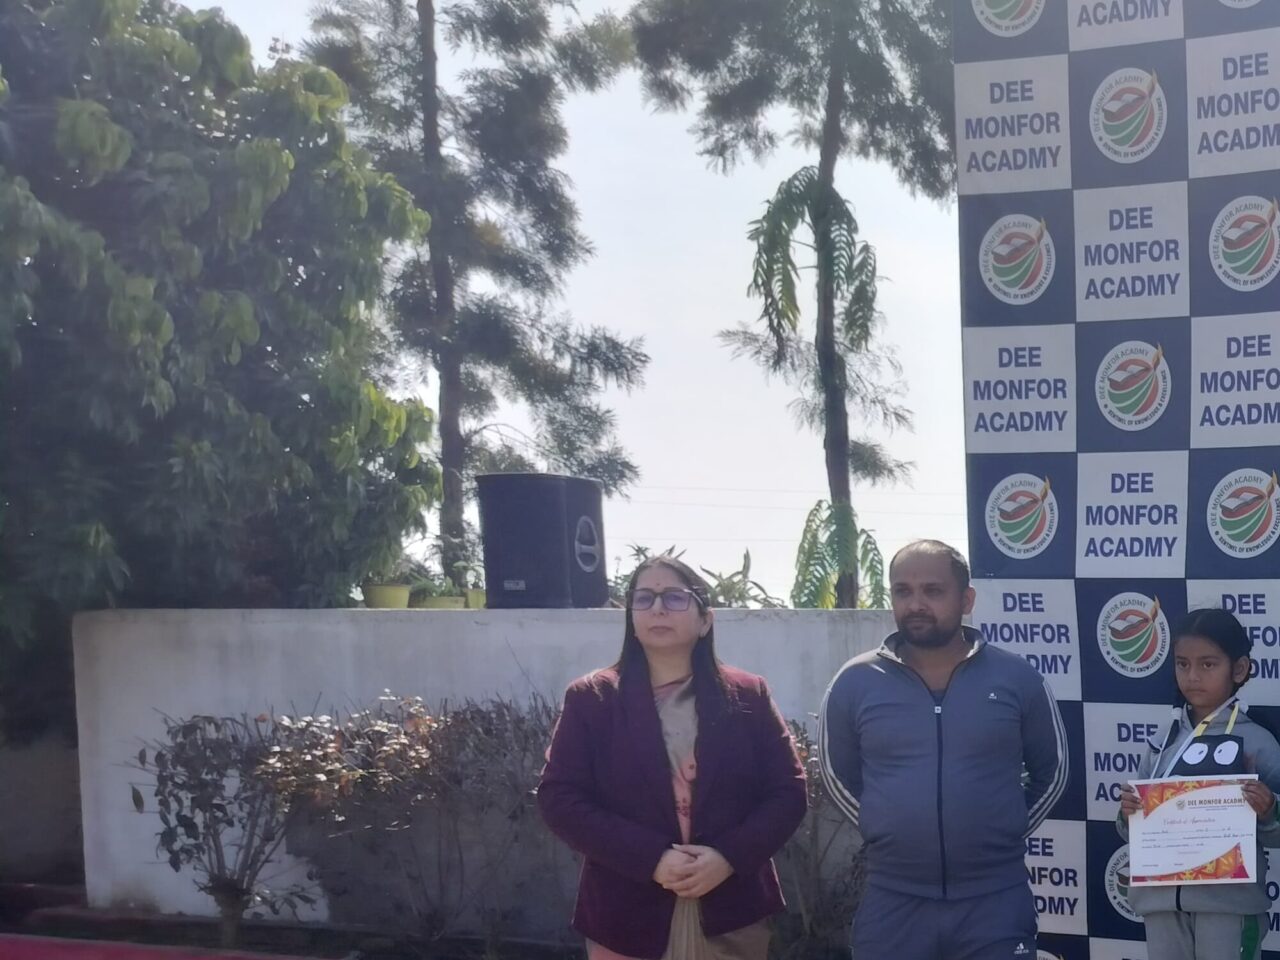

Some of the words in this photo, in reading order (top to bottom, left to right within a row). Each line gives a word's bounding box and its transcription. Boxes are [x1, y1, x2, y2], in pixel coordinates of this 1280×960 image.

[1077, 0, 1171, 27] ACADMY
[1222, 52, 1269, 81] DEE
[989, 79, 1034, 104] DEE
[965, 112, 1060, 140] MONFOR
[966, 145, 1061, 173] ACADMY
[1109, 206, 1153, 231] DEE
[1084, 239, 1179, 266] MONFOR
[1085, 273, 1180, 300] ACADMY
[998, 346, 1042, 368] DEE
[1226, 334, 1271, 359] DEE
[973, 378, 1067, 400] MONFOR
[974, 410, 1068, 432] ACADMY
[1111, 472, 1154, 493] DEE
[1086, 504, 1178, 526] MONFOR
[1084, 536, 1178, 557] ACADMY
[1002, 593, 1045, 612] DEE
[1222, 594, 1266, 614] DEE
[980, 623, 1070, 644] MONFOR
[1094, 752, 1141, 772] MON
[1028, 837, 1054, 857] EE
[1027, 866, 1078, 887] NFOR
[1034, 895, 1079, 916] DMY
